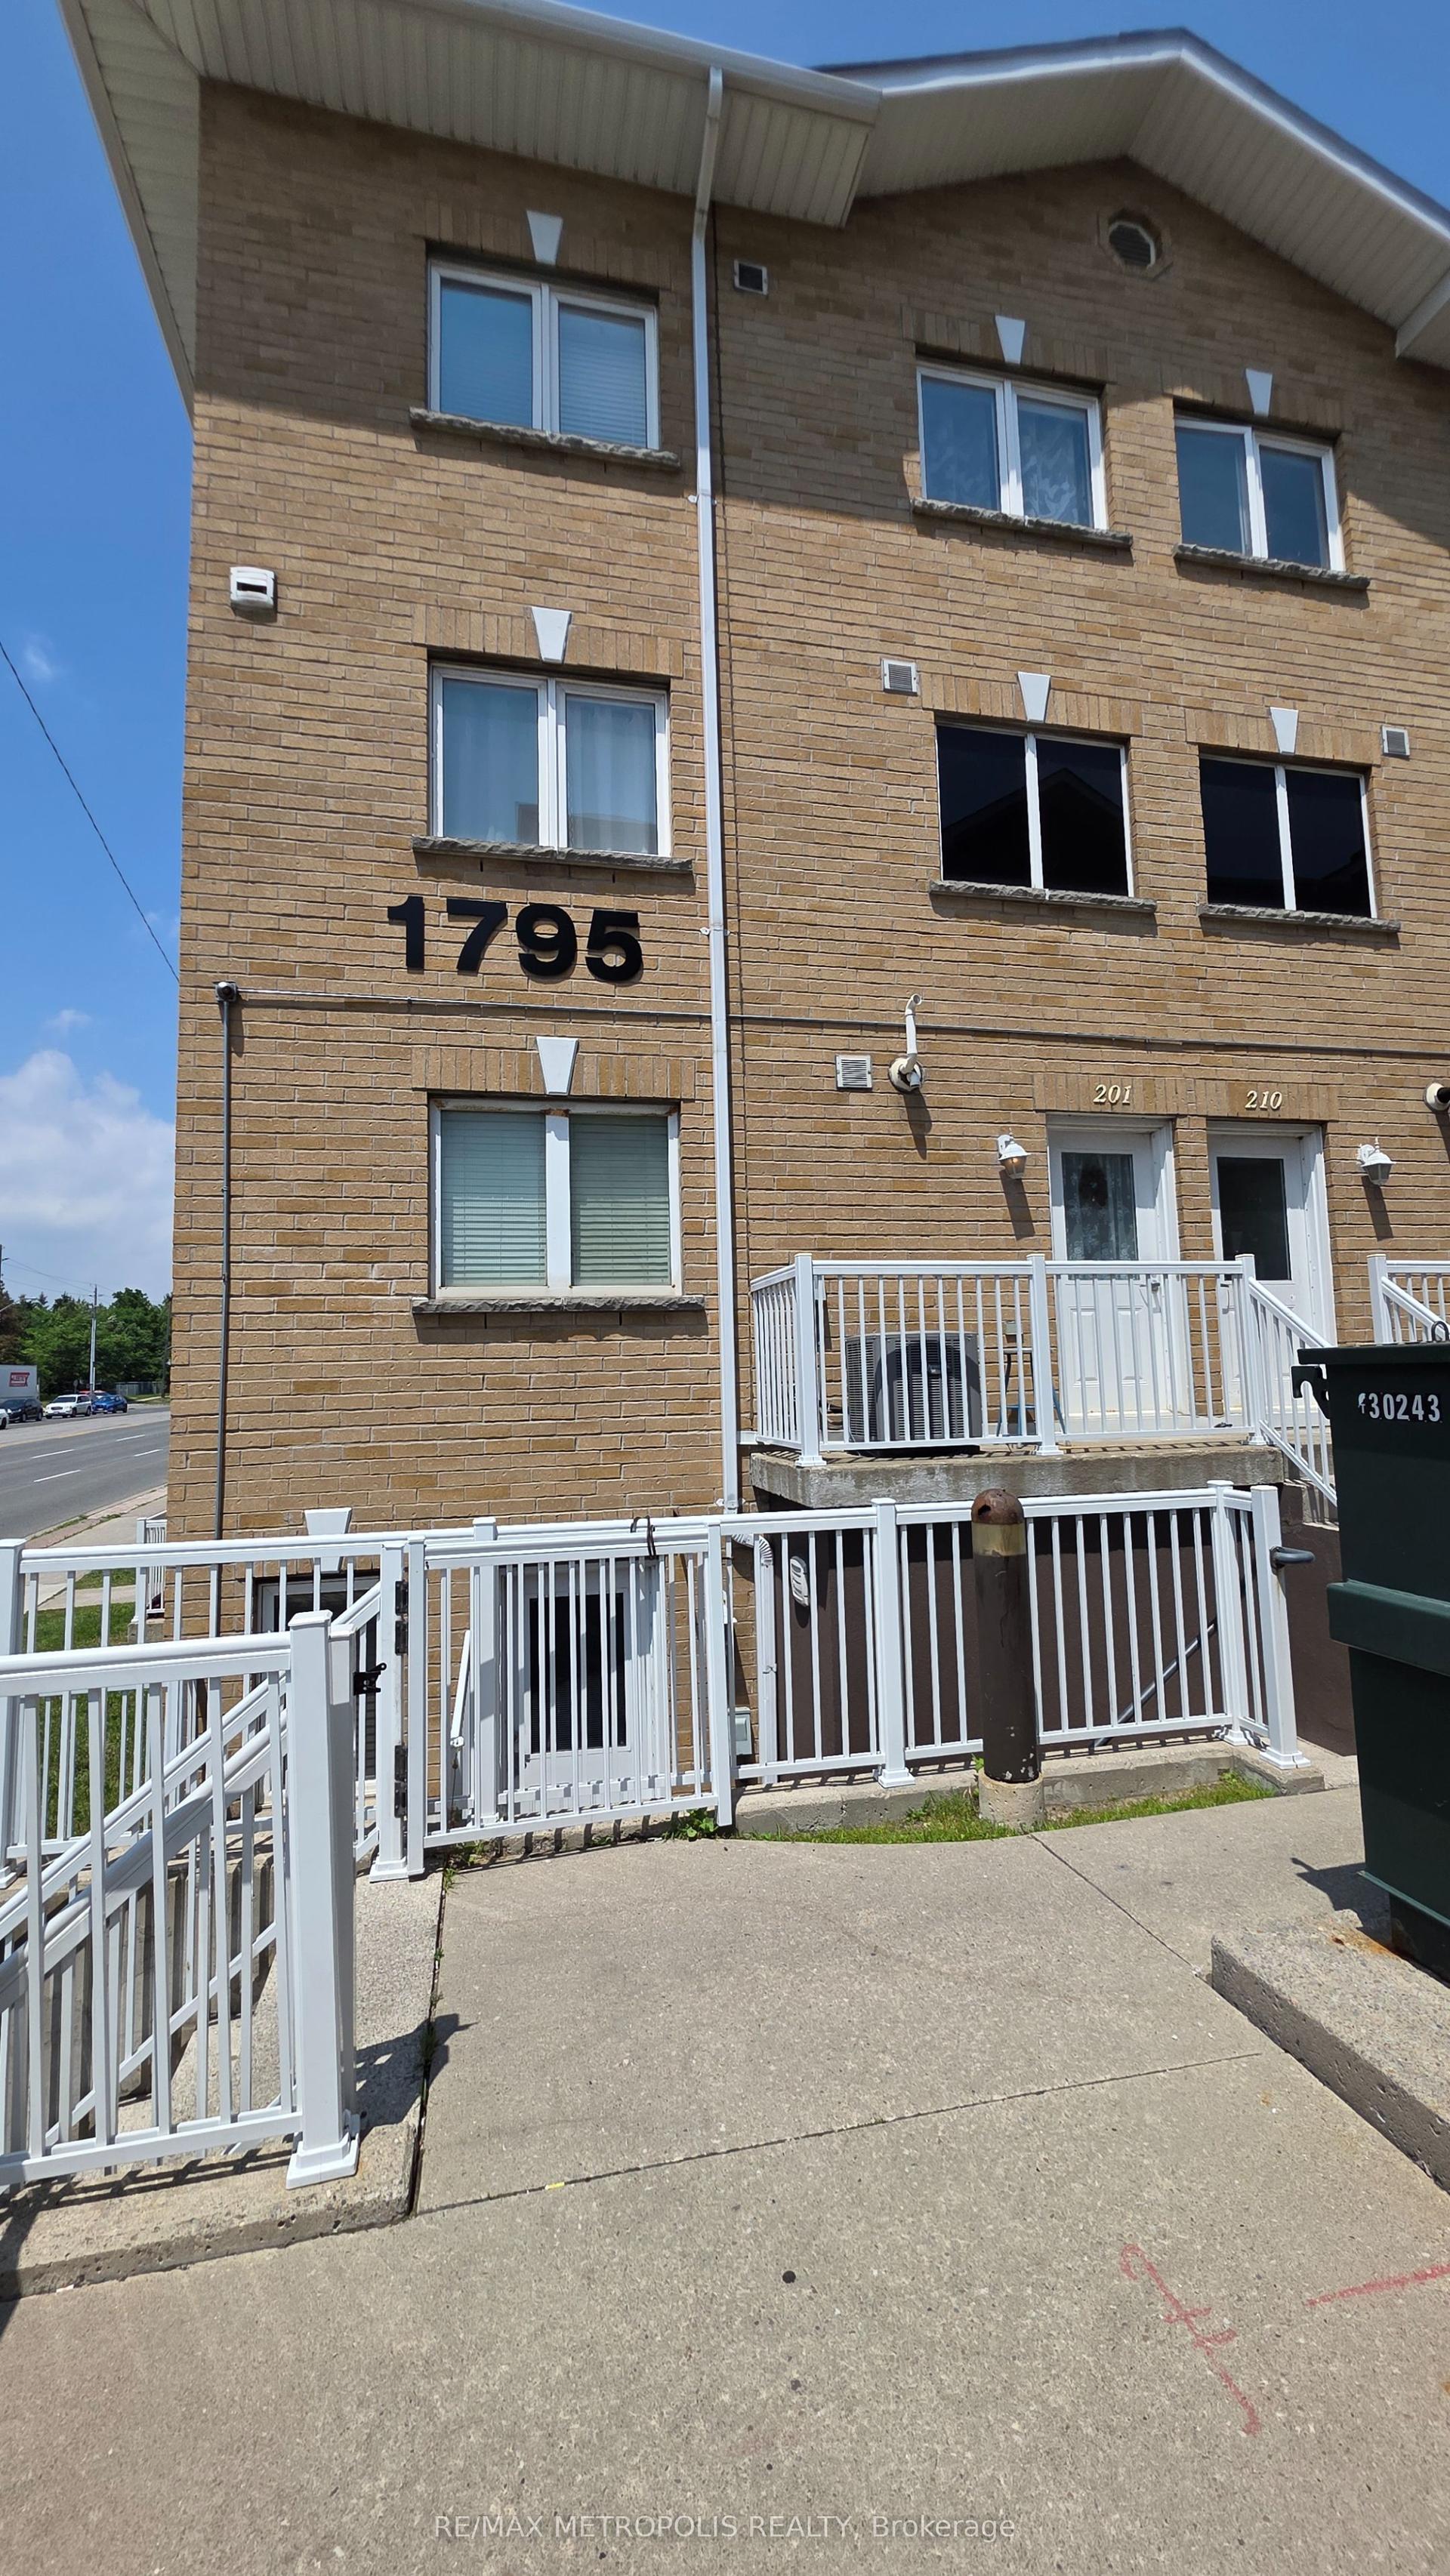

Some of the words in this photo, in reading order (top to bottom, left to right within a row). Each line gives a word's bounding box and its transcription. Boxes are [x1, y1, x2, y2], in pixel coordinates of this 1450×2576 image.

[387, 895, 643, 984] 1795
[1094, 1084, 1132, 1105] 201
[1245, 1090, 1283, 1110] 210
